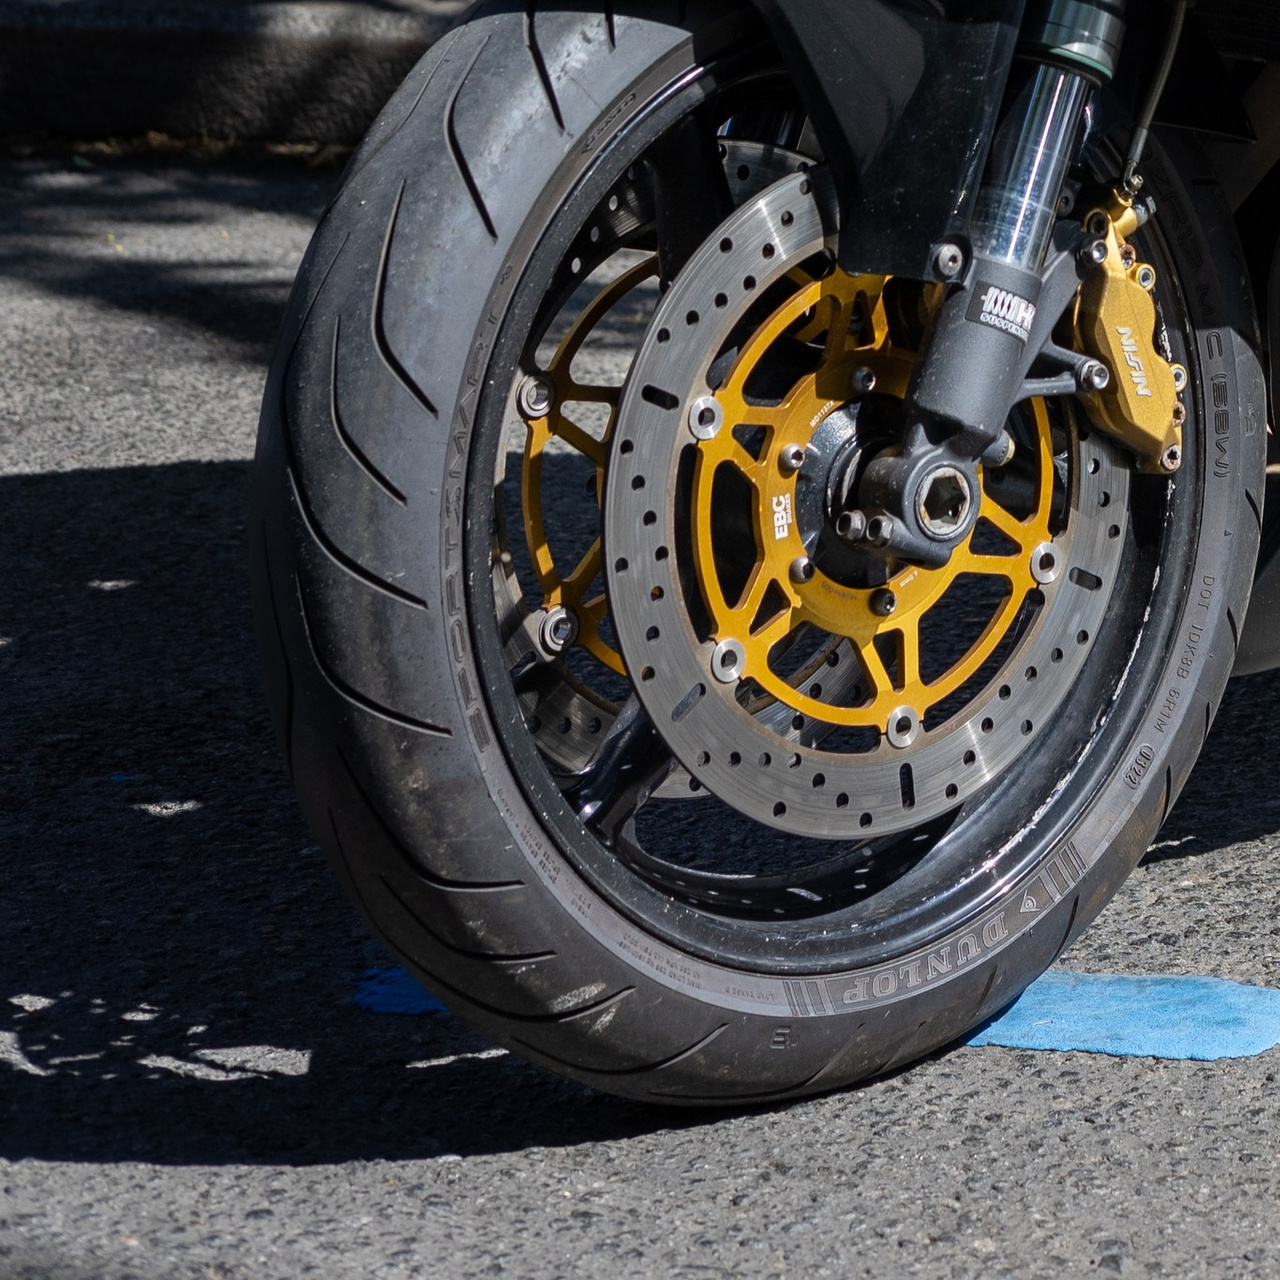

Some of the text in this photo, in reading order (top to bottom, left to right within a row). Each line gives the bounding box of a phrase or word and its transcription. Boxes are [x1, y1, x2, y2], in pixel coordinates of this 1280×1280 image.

[1116, 326, 1152, 397] NISSIN
[773, 495, 789, 540] EBC
[1197, 574, 1215, 610] DOT
[842, 910, 1011, 1005] DUNLOP
